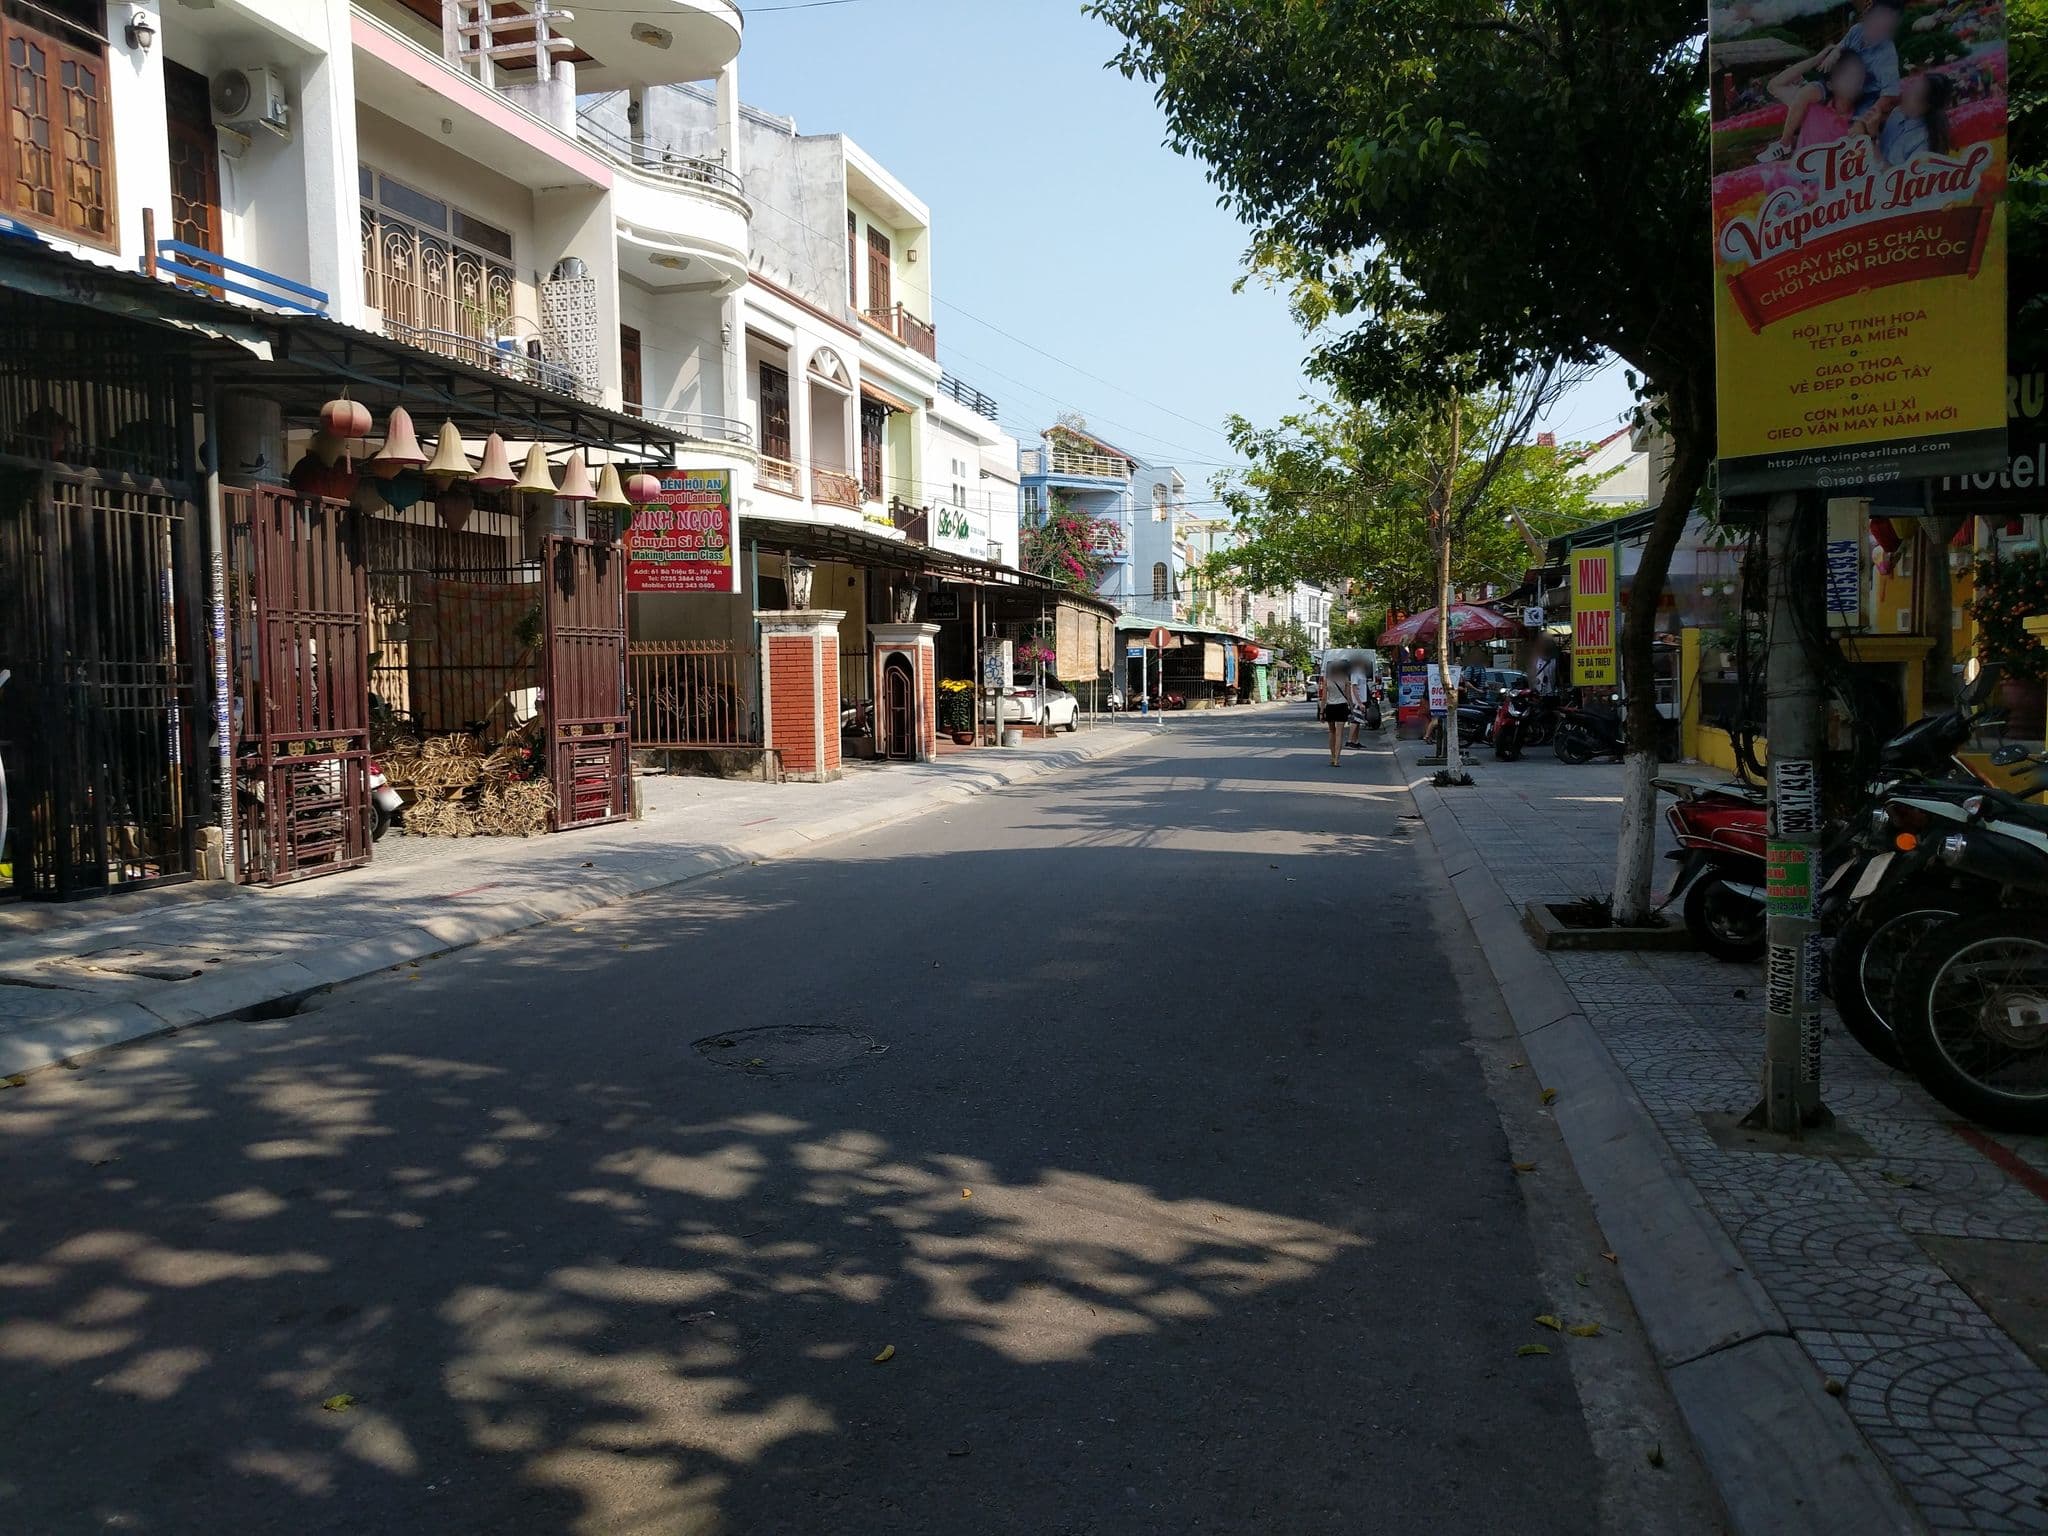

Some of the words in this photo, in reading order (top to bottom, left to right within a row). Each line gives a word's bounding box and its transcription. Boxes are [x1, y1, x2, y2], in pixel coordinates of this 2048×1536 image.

[1724, 176, 1875, 260] Vinpearl
[1881, 146, 1989, 210] Land
[1868, 236, 1878, 251] 5
[1883, 225, 1943, 247] CHÂU
[1759, 279, 1804, 306] CHƠI
[1808, 258, 1859, 287] XUÂN
[1864, 241, 1920, 269] RƯỚC
[1925, 239, 1967, 261] LỘC
[1848, 316, 1885, 331] TINH
[1890, 309, 1927, 323] HOA
[1841, 334, 1862, 347] BA
[1816, 363, 1854, 377] GIAO
[1858, 355, 1904, 370] THOA
[1850, 370, 1897, 387] ĐÔNG
[1767, 427, 1803, 441] GIEO
[1844, 417, 1878, 432] MAY
[1925, 405, 1957, 422] MỚI
[1804, 407, 1837, 422] CƠN
[1842, 402, 1878, 418] MƯA
[706, 479, 721, 490] AN
[1833, 475, 1863, 487] 1900
[1868, 471, 1901, 483] 6677
[676, 493, 685, 503] of
[687, 493, 721, 504] Lantern
[631, 510, 674, 531] MINH
[677, 509, 723, 534] NGỌC
[695, 536, 705, 547] &
[631, 550, 664, 561] Making
[665, 550, 698, 560] Lantern
[700, 550, 724, 560] Class
[1579, 558, 1607, 595] MINI
[1577, 610, 1611, 647] MART
[1780, 762, 1812, 834] 0908.17.43.43
